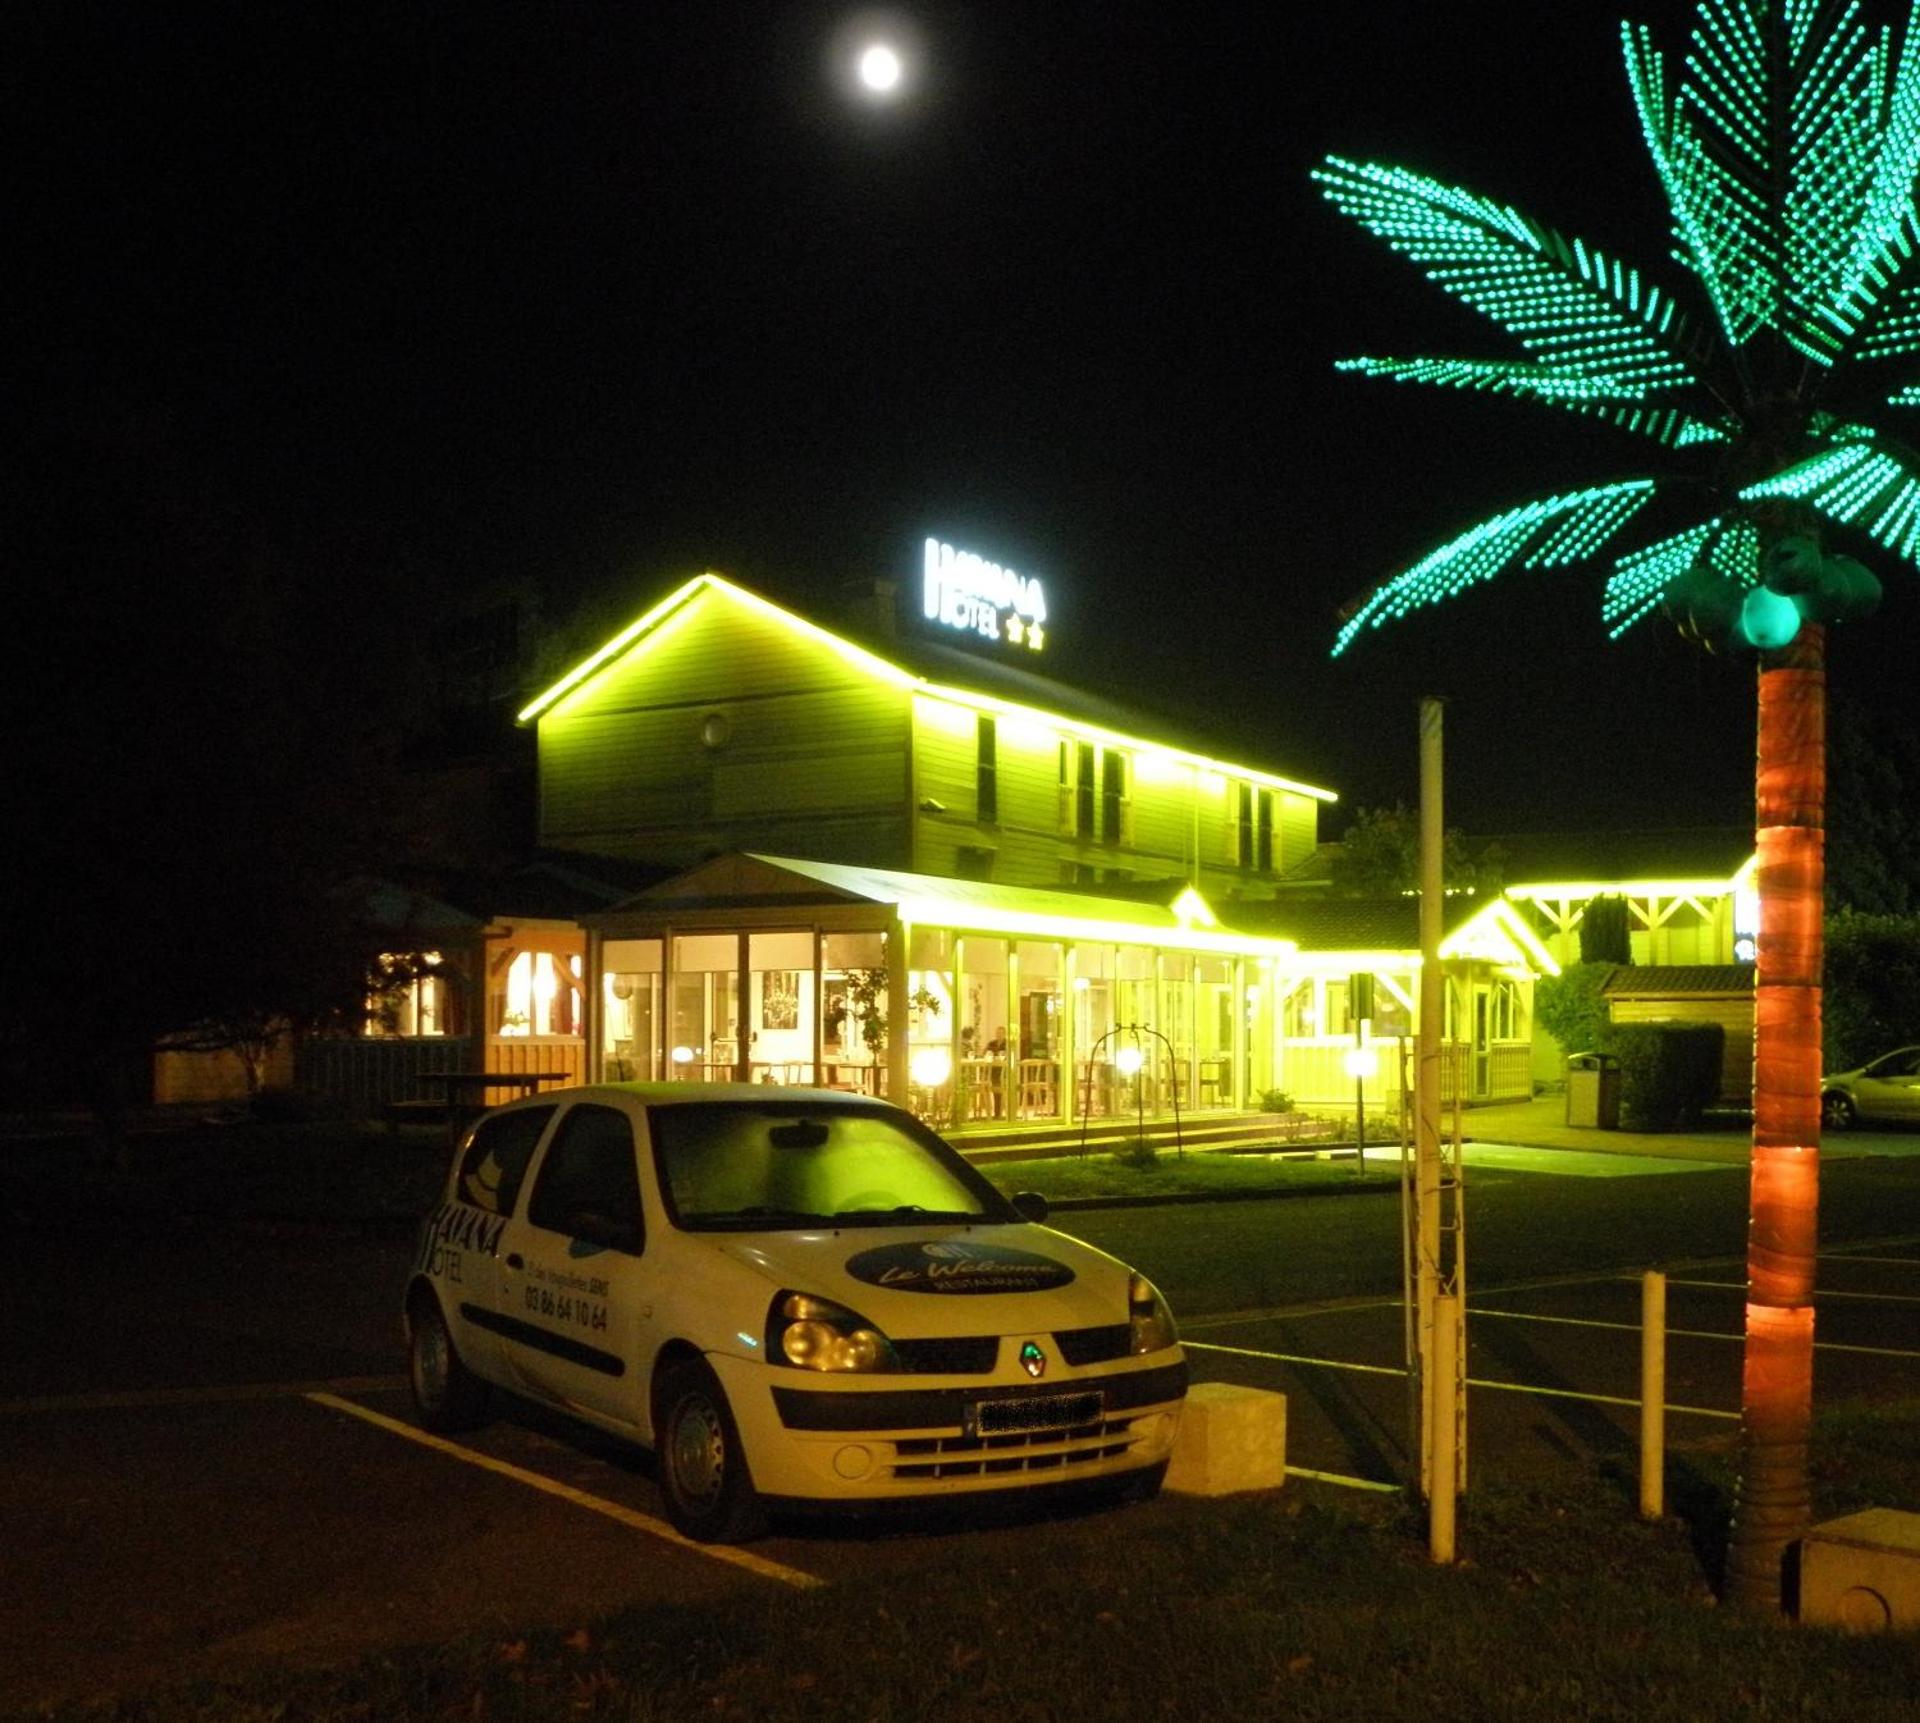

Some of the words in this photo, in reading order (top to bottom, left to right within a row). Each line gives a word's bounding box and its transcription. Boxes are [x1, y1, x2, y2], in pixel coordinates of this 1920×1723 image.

[525, 1284, 539, 1311] 03
[557, 1295, 572, 1322] 64
[575, 1299, 589, 1327] 10
[591, 1304, 607, 1333] 64
